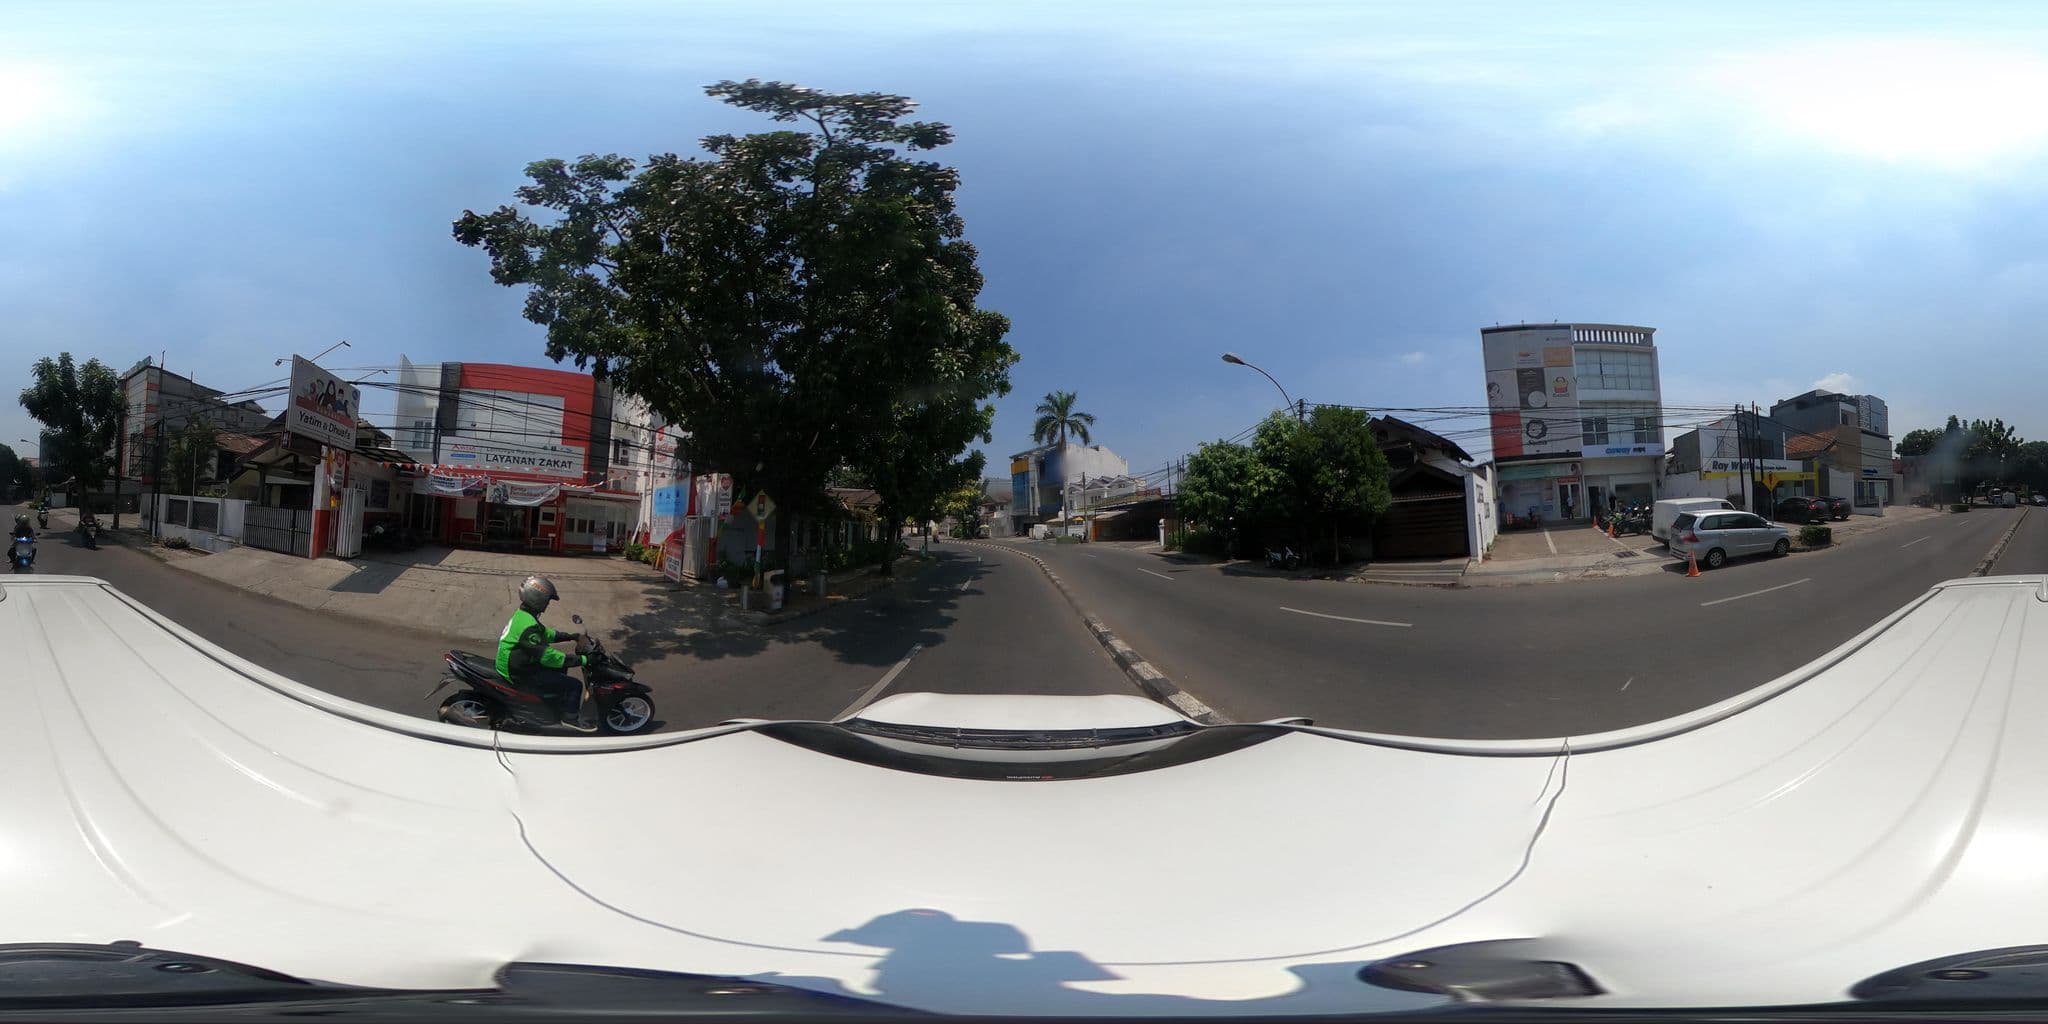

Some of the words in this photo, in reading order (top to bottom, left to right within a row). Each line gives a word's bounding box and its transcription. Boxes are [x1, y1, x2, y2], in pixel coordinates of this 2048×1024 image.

[299, 411, 322, 428] Yatim
[485, 453, 535, 466] LAYANAN
[538, 458, 573, 470] ZAKAT
[1712, 460, 1729, 472] Ray
